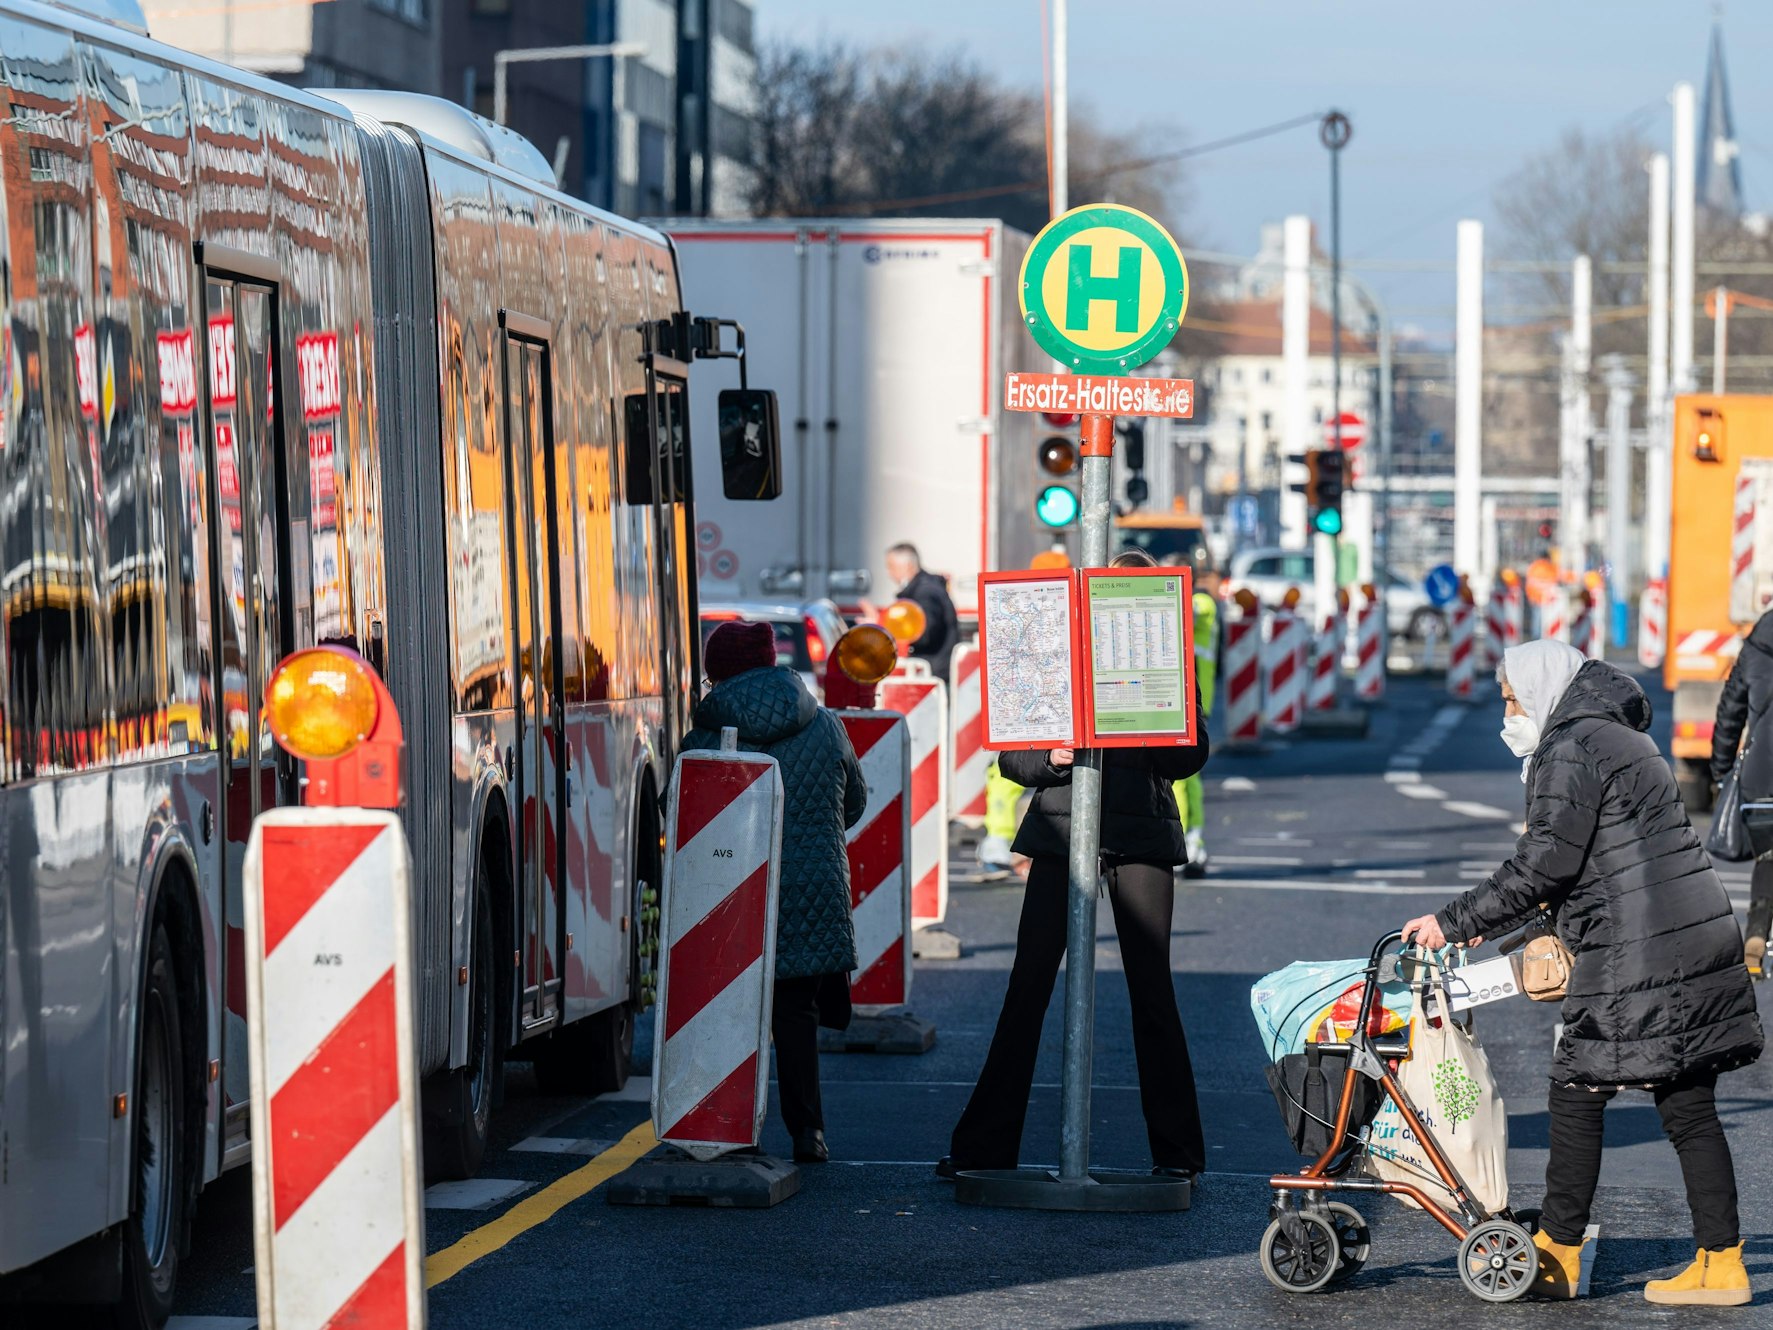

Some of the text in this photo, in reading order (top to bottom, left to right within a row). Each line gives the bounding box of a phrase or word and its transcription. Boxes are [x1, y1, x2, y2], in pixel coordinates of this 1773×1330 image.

[1065, 244, 1142, 333] H
[713, 849, 733, 858] AVS
[313, 953, 343, 967] AVS
